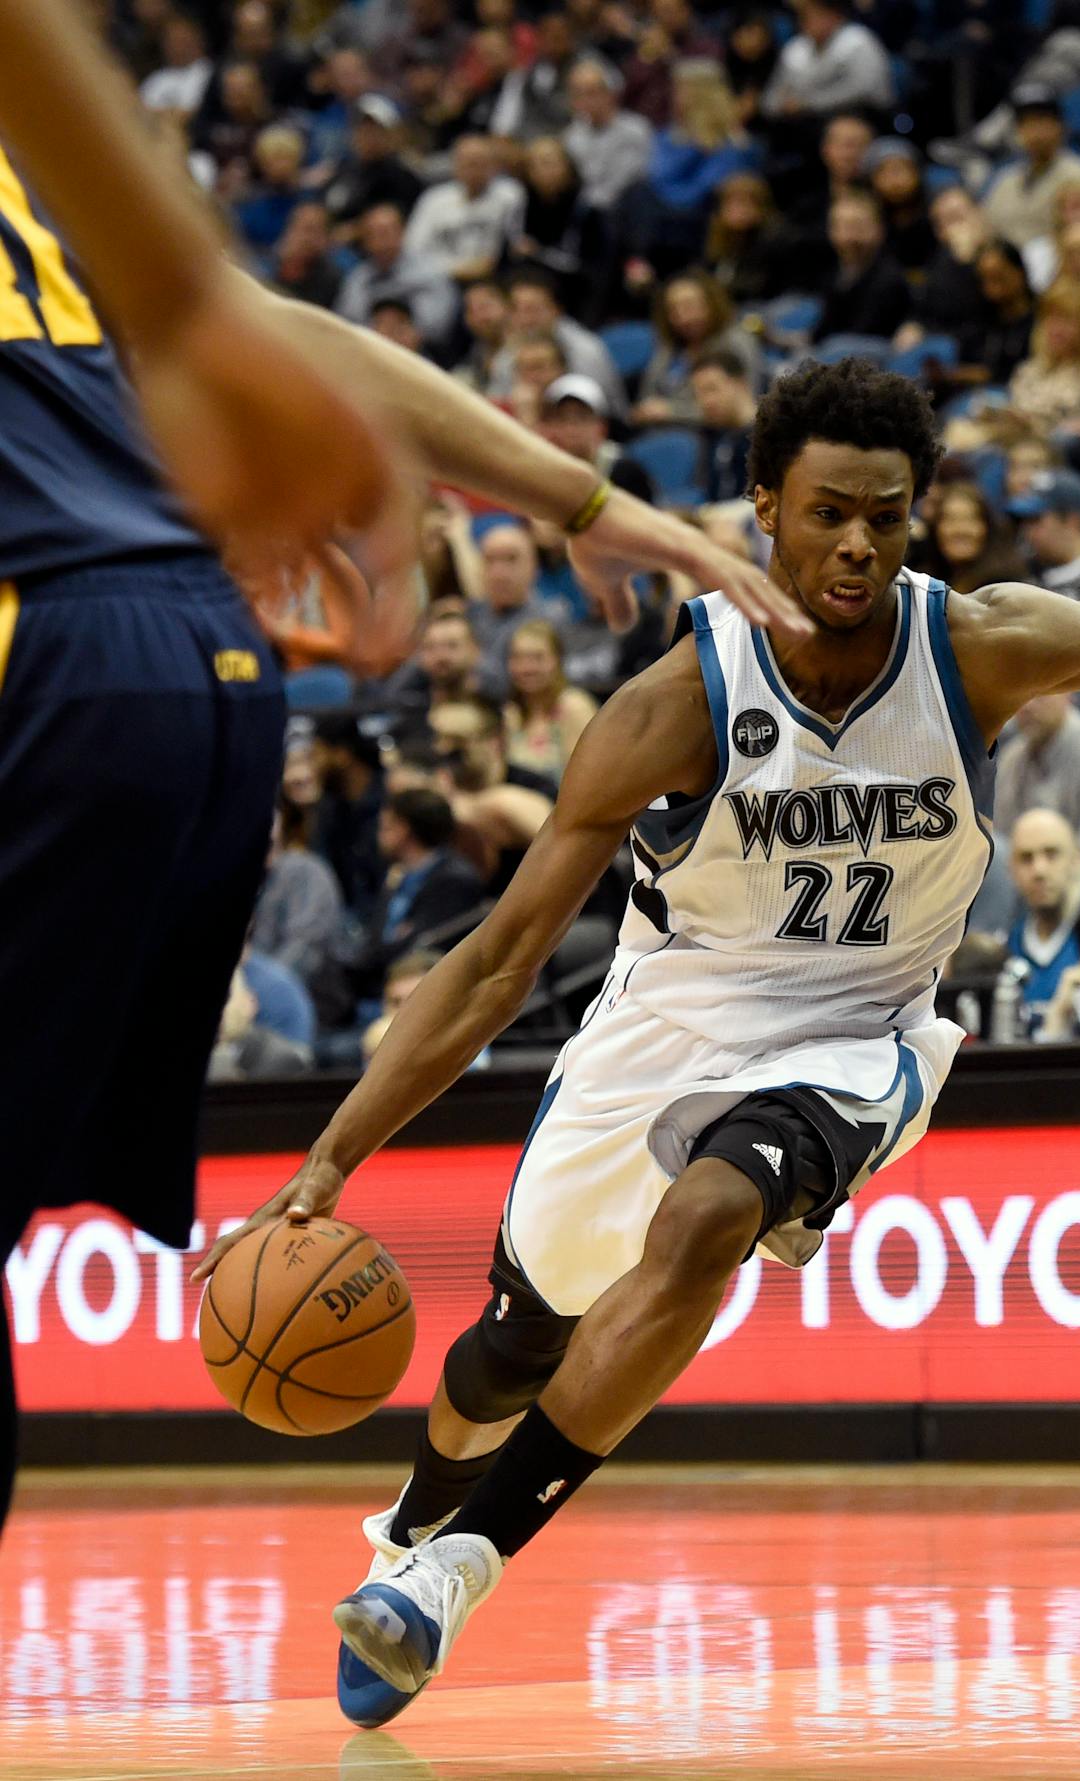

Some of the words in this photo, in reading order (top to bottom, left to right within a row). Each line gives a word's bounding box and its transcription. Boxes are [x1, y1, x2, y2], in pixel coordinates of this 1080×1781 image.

[737, 725, 773, 742] FLIP
[722, 777, 957, 862] WOLVES
[775, 860, 894, 947] 22
[752, 1143, 780, 1176] adidas
[5, 1218, 249, 1344] YOT
